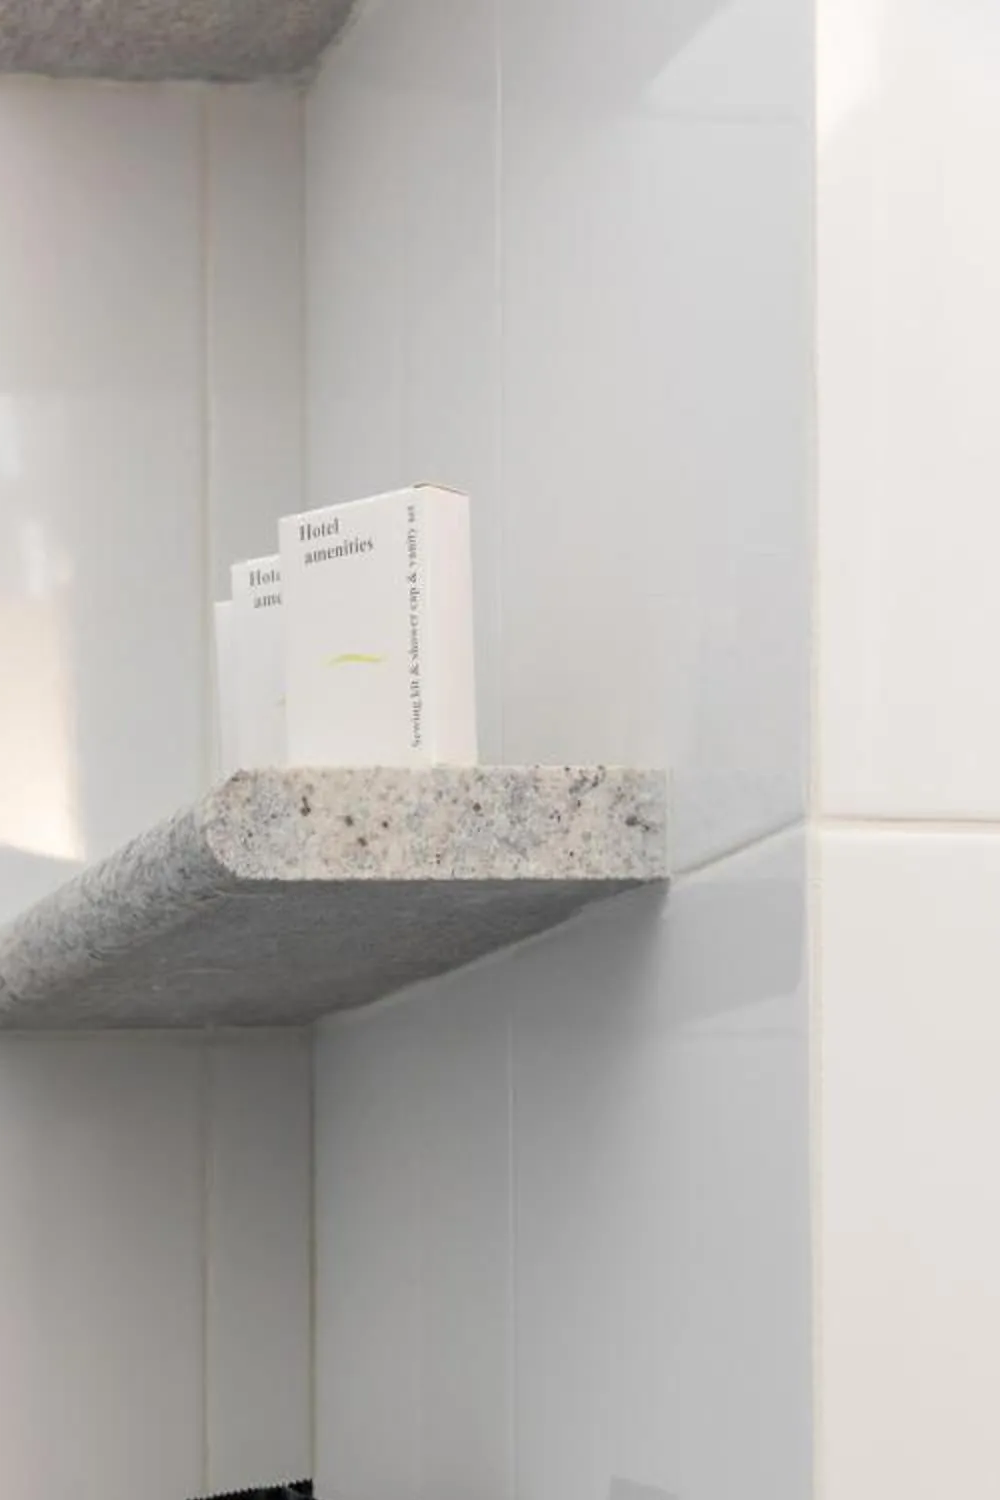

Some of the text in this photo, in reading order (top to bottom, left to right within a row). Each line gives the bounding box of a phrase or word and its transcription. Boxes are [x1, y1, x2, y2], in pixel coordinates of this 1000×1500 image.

[300, 516, 339, 541] Hotel
[304, 536, 374, 565] amenities
[406, 527, 417, 568] vanity
[406, 571, 417, 584] &
[409, 587, 420, 611] cap
[407, 613, 419, 660] shower
[408, 662, 419, 676] &
[409, 680, 420, 698] kit
